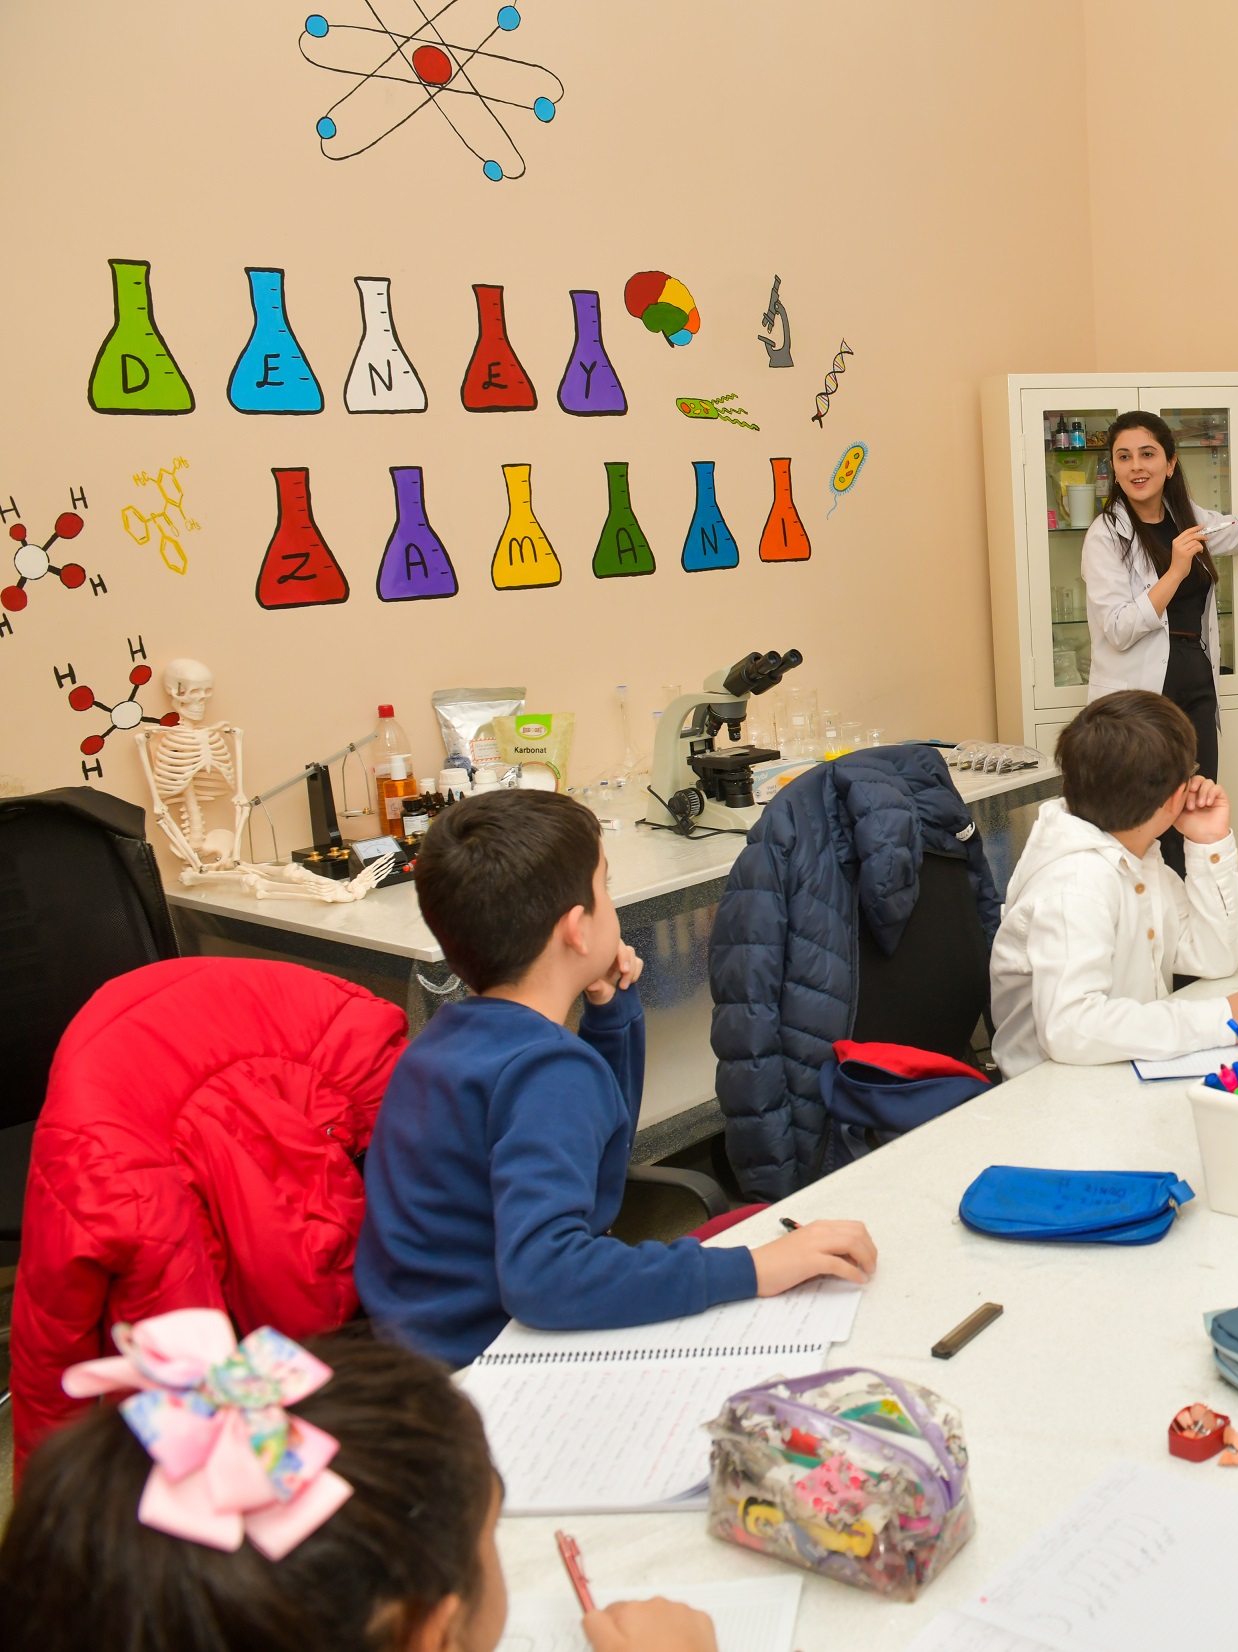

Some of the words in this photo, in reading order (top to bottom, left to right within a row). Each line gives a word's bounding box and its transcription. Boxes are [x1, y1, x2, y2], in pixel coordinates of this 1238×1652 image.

[69, 486, 88, 509] H
[89, 573, 108, 597] H
[127, 635, 147, 662] H
[53, 663, 76, 689] H
[514, 746, 547, 754] Karbonat
[81, 758, 103, 781] H
